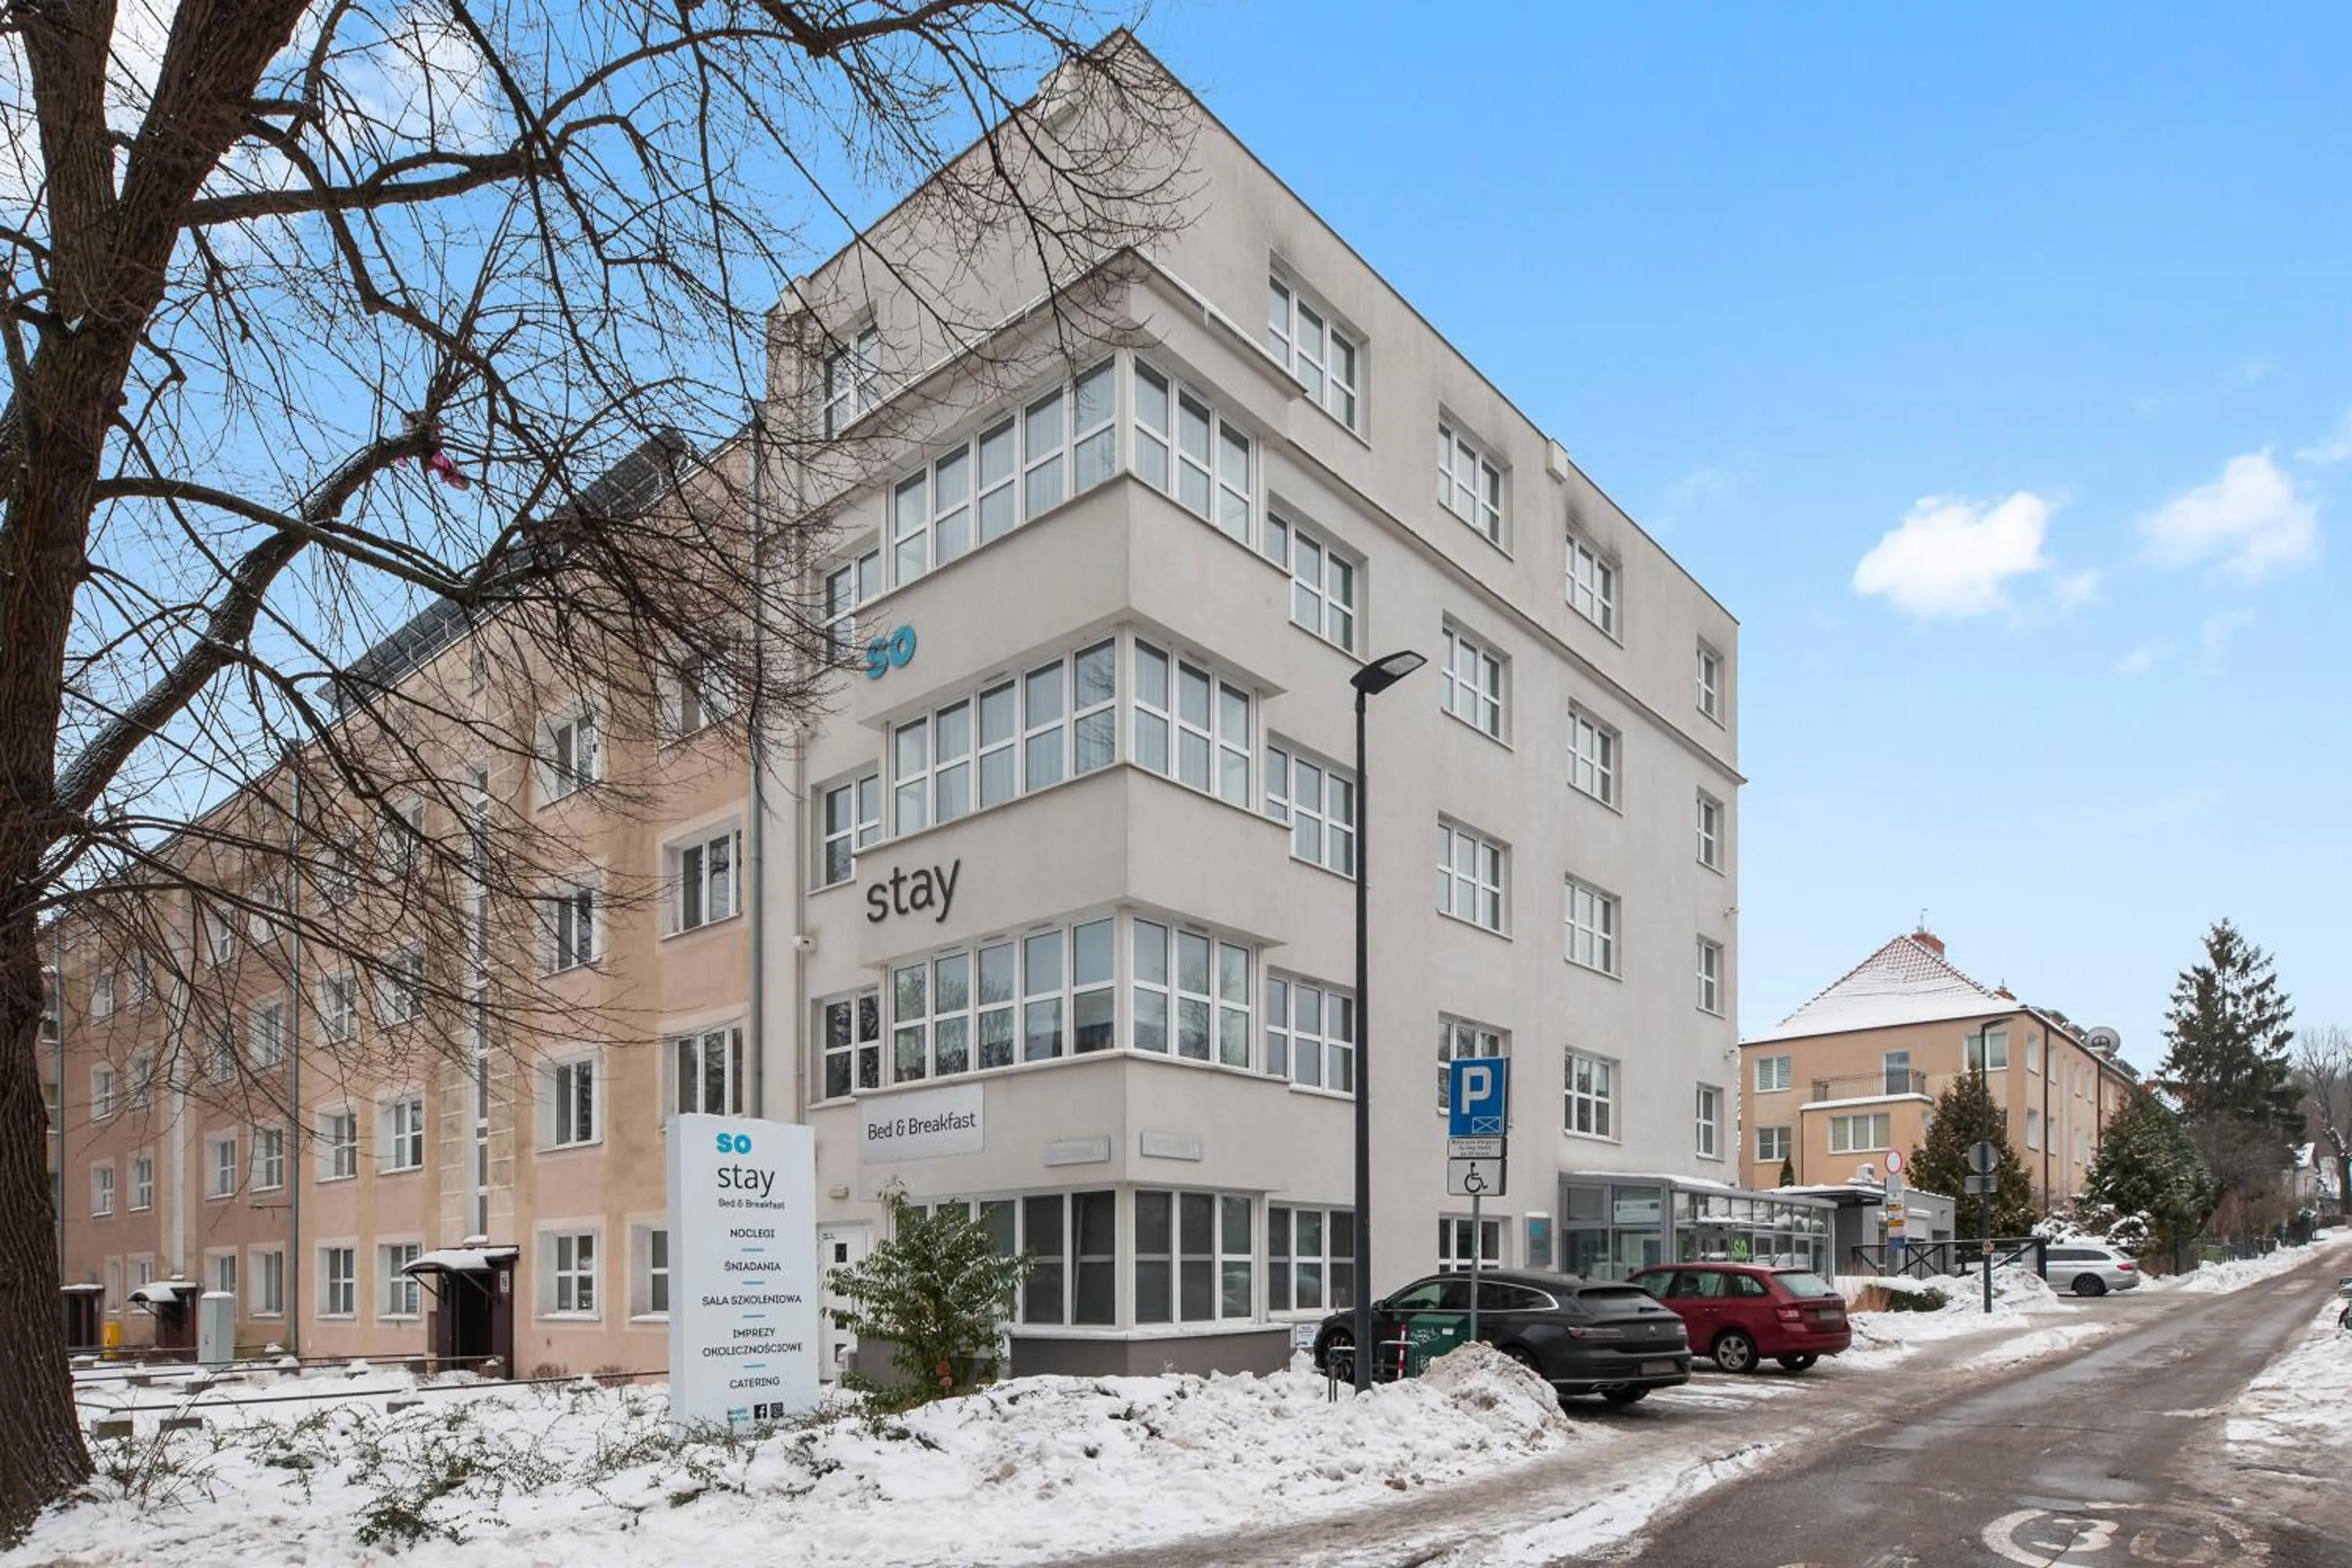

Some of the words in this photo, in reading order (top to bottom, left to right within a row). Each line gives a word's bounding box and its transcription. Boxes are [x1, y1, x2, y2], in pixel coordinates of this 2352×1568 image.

[866, 858, 960, 923] stay
[1461, 1066, 1492, 1114] P
[868, 1121, 893, 1141] Bed
[896, 1119, 906, 1136] &
[909, 1111, 977, 1134] Breakfast
[717, 1163, 775, 1198] stay
[717, 1197, 735, 1208] Bed
[746, 1199, 785, 1210] Breakfast
[730, 1229, 775, 1238] NOCLEGI
[724, 1260, 782, 1271] ŚNIADANIA
[702, 1296, 729, 1306] SALA
[731, 1294, 802, 1305] SZKOLENIOWA
[733, 1327, 775, 1338] IMPREZY
[702, 1342, 803, 1357] OKOLICZNOŚCIOWE
[729, 1376, 780, 1388] CATERING
